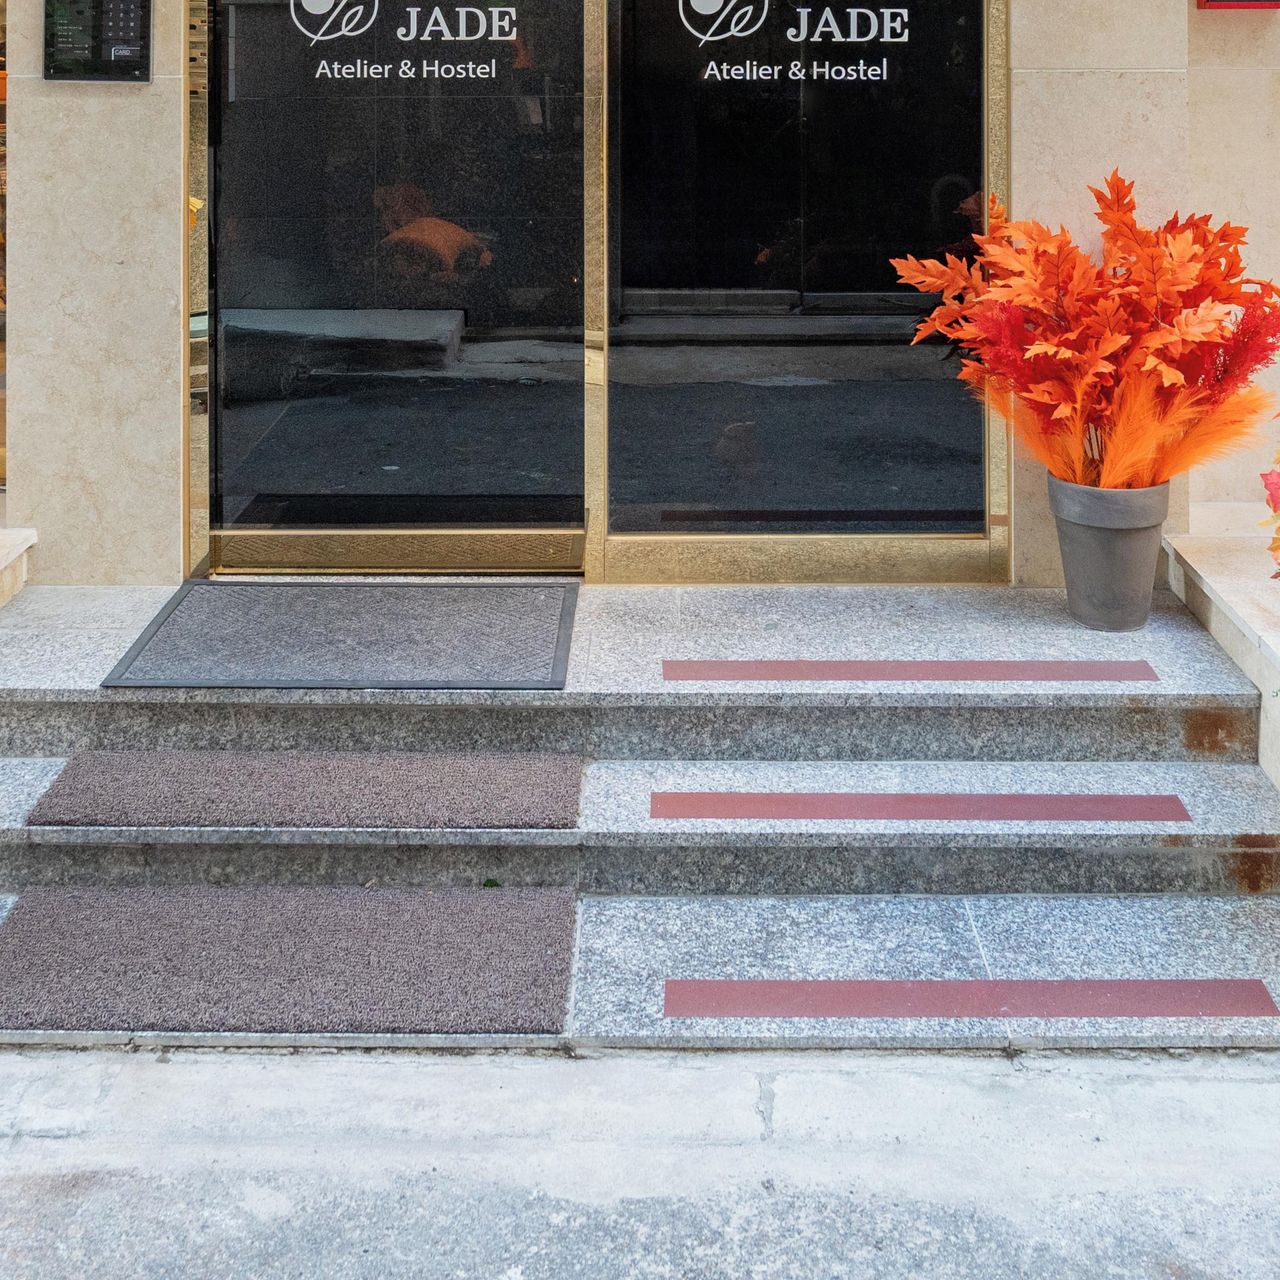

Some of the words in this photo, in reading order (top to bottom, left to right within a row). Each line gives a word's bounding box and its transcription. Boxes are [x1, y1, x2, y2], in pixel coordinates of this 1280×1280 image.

[397, 7, 517, 41] JADE
[786, 7, 910, 42] JADE
[315, 59, 393, 79] Atelier
[398, 59, 415, 79] &
[422, 59, 497, 79] Hostel
[703, 60, 782, 81] Atelier
[787, 61, 806, 80] &
[812, 59, 888, 81] Hostel
